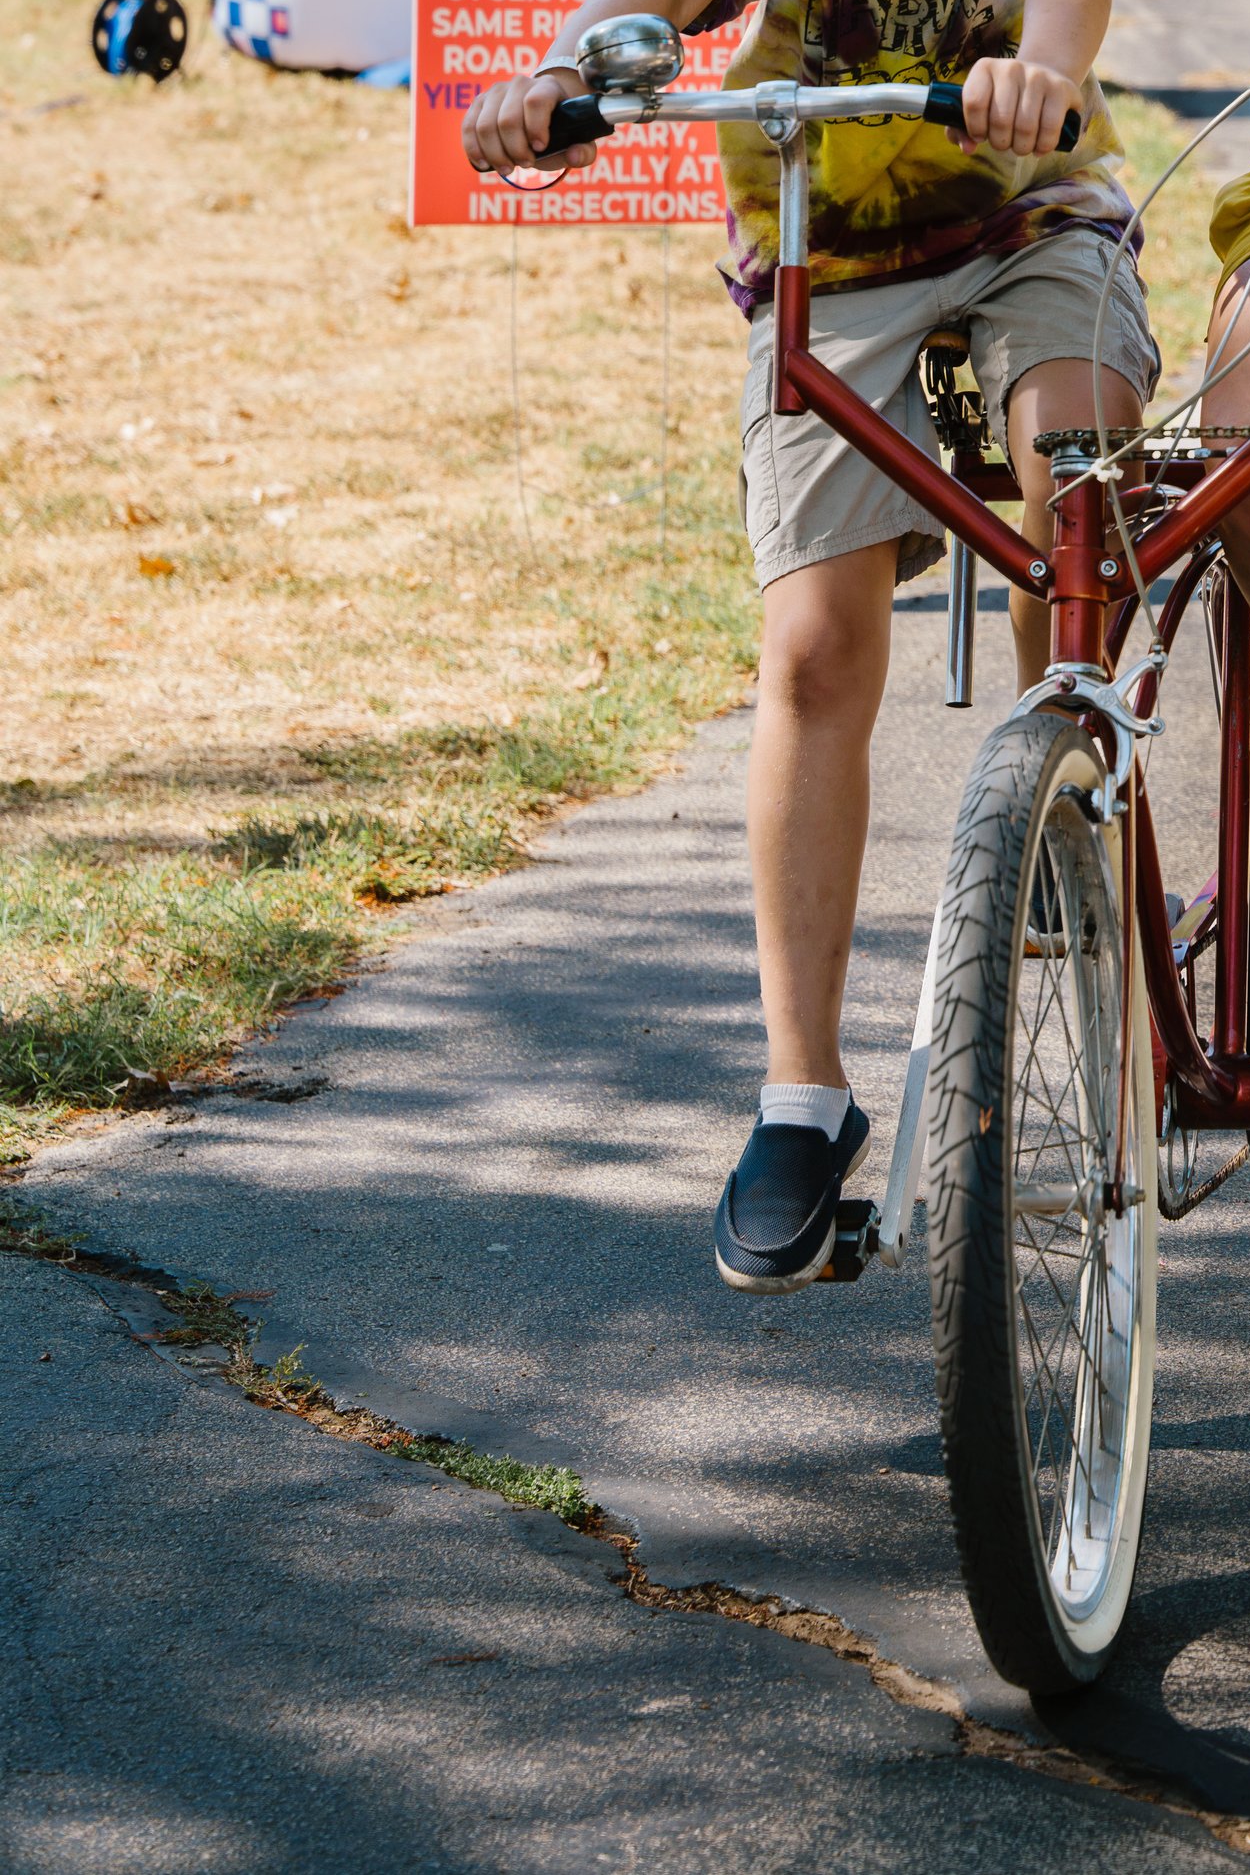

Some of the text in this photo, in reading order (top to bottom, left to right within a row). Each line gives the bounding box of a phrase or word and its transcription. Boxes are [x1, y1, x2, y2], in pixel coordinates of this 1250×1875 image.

[431, 7, 524, 38] SAME
[443, 44, 538, 74] ROAD
[675, 154, 720, 185] AT
[469, 189, 726, 222] INTERSECTIONS.
